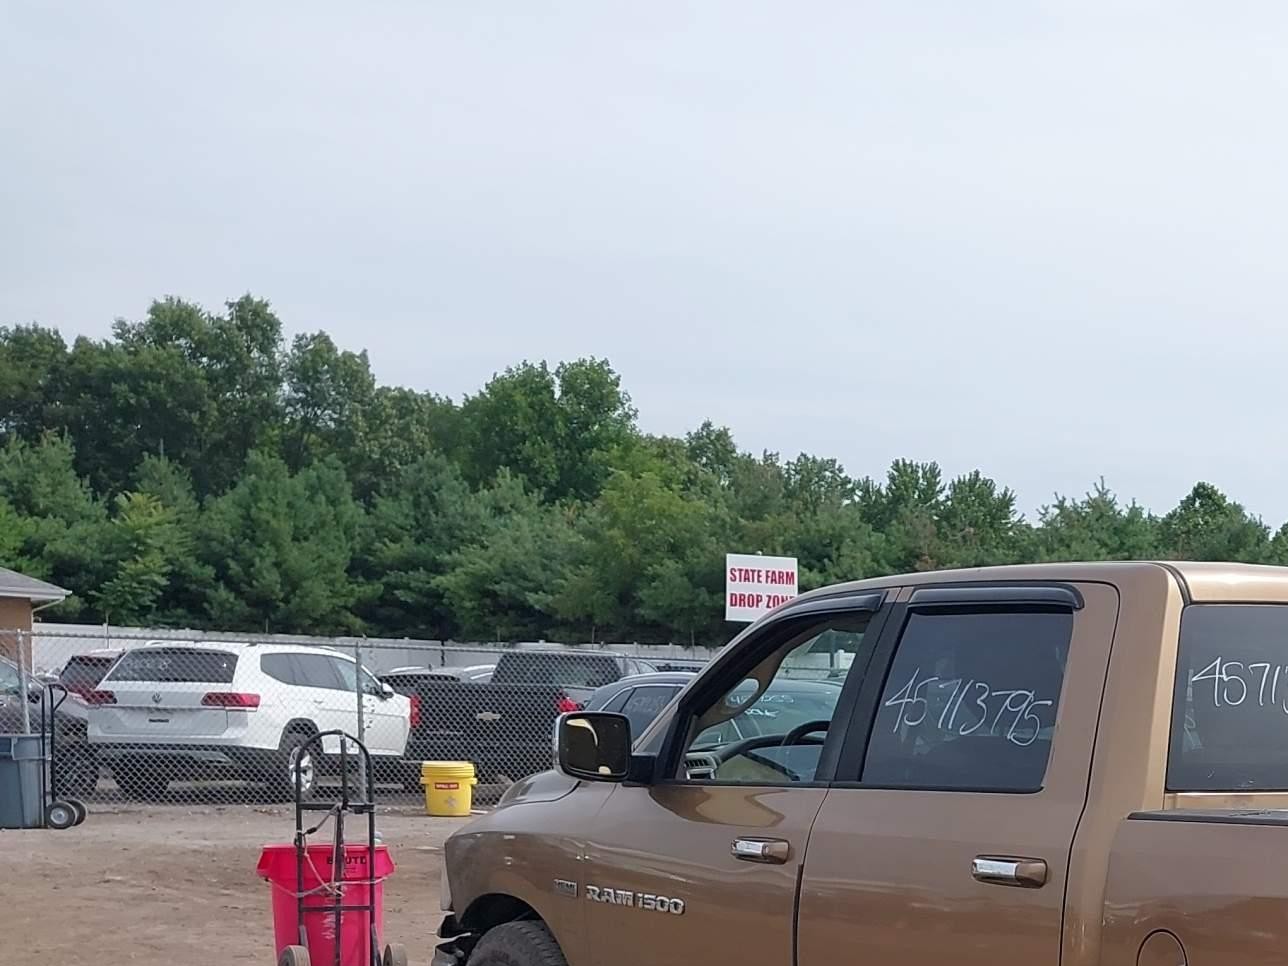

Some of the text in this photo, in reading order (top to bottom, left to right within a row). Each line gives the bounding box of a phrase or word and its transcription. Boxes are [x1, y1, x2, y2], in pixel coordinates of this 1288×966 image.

[729, 567, 795, 585] STATE FARM
[729, 592, 796, 609] DROP ZO
[885, 667, 1053, 746] 45713795
[586, 885, 685, 915] RAM 1500
